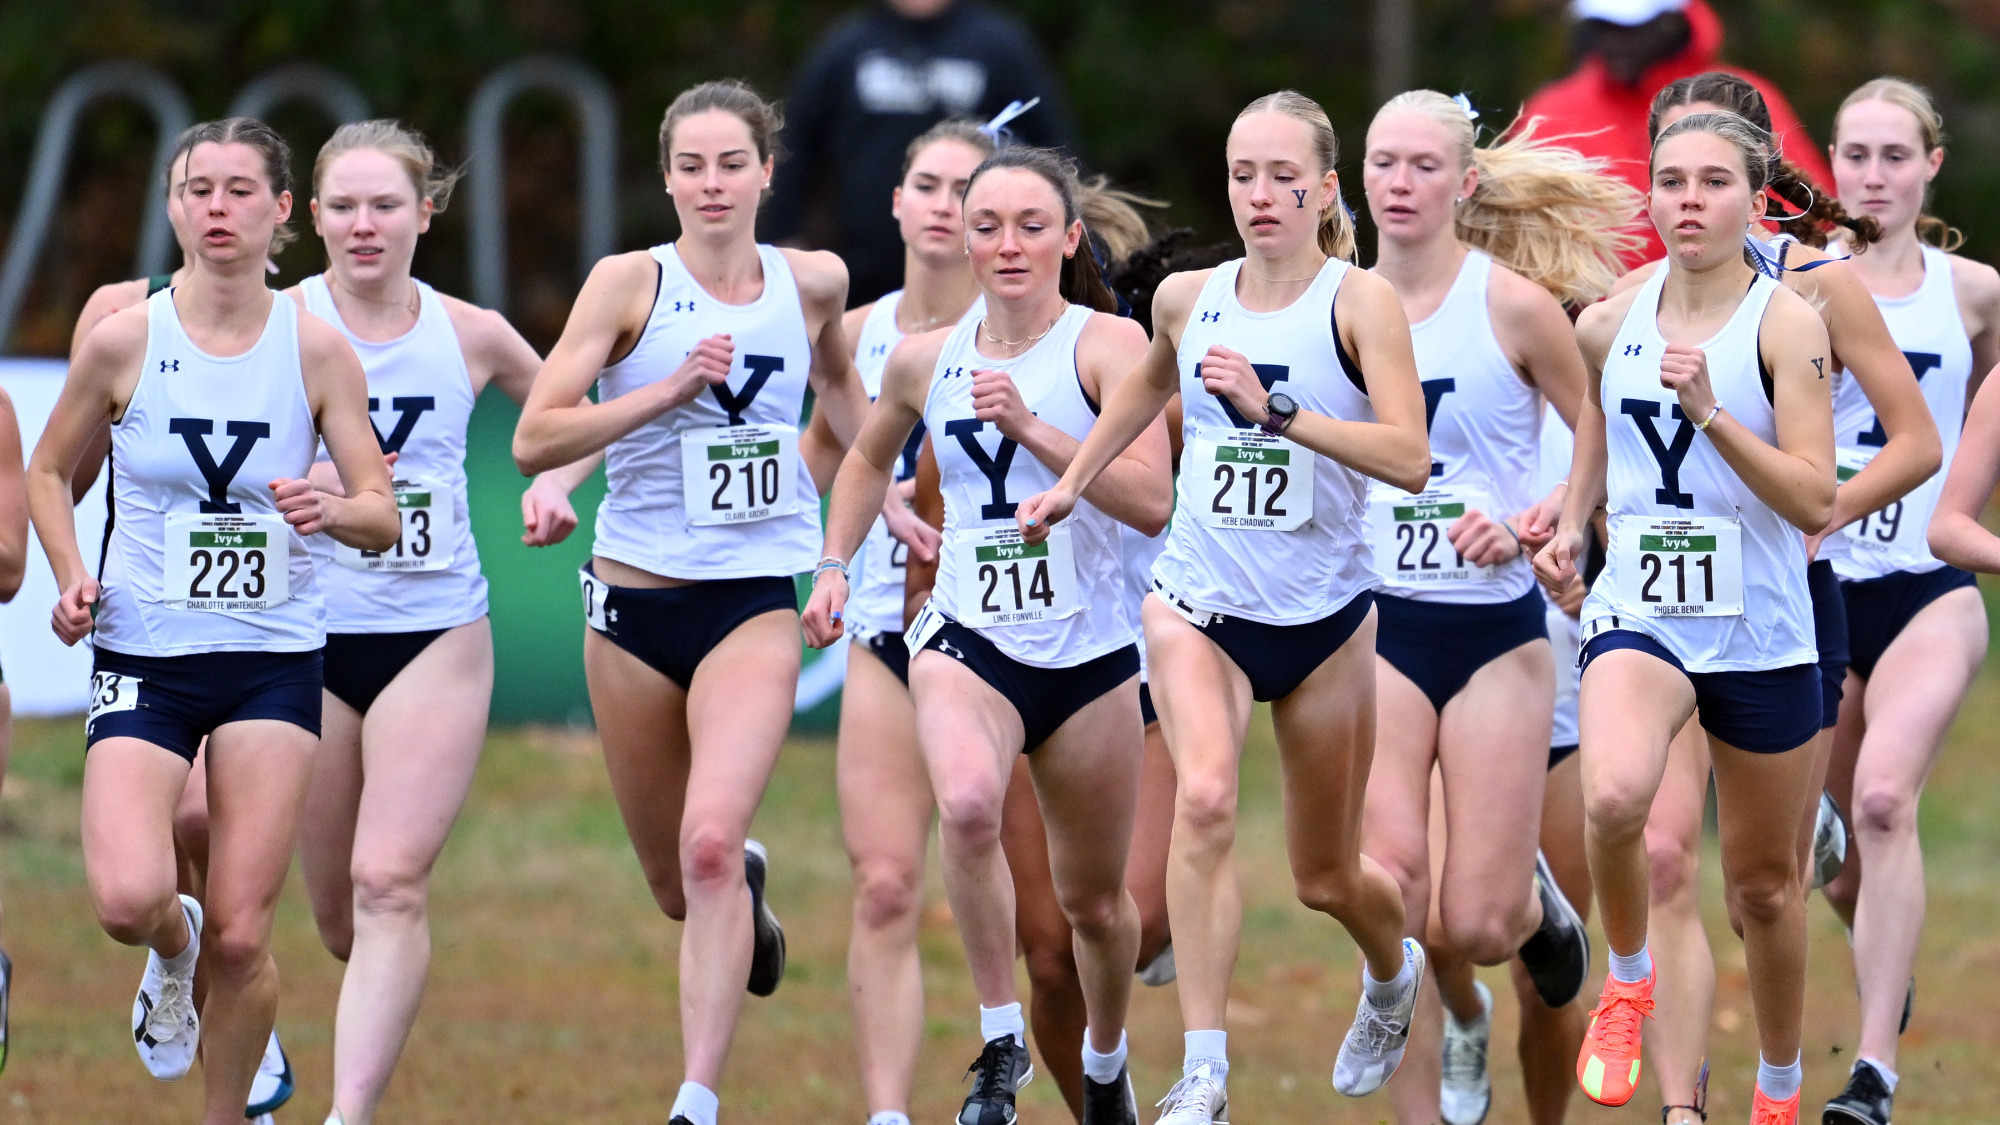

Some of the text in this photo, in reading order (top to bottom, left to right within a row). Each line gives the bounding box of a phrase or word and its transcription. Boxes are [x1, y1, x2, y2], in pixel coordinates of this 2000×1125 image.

[1291, 189, 1307, 208] Y
[1811, 357, 1824, 379] Y
[730, 445, 751, 457] Ivy
[1237, 448, 1256, 461] Ivy
[1621, 398, 1694, 509] Y
[169, 418, 270, 513] Y
[945, 412, 1037, 520] Y
[709, 458, 779, 511] 210
[1212, 464, 1288, 516] 212
[725, 511, 746, 521] CLAIRE
[1413, 507, 1432, 519] Ivy
[1222, 516, 1275, 527] HEBE CHADWICK
[214, 533, 233, 545] Ivy
[360, 510, 431, 557] 13
[1662, 537, 1681, 550] Ivy
[996, 546, 1014, 558] Ivy
[189, 549, 266, 598] 223
[1640, 553, 1714, 603] 211
[978, 559, 1055, 613] 214
[187, 600, 267, 610] CHARLOTTE WHITEHURST
[1654, 605, 1704, 614] PHOEBE BENUN
[993, 610, 1043, 623] LINDE FONVILLE
